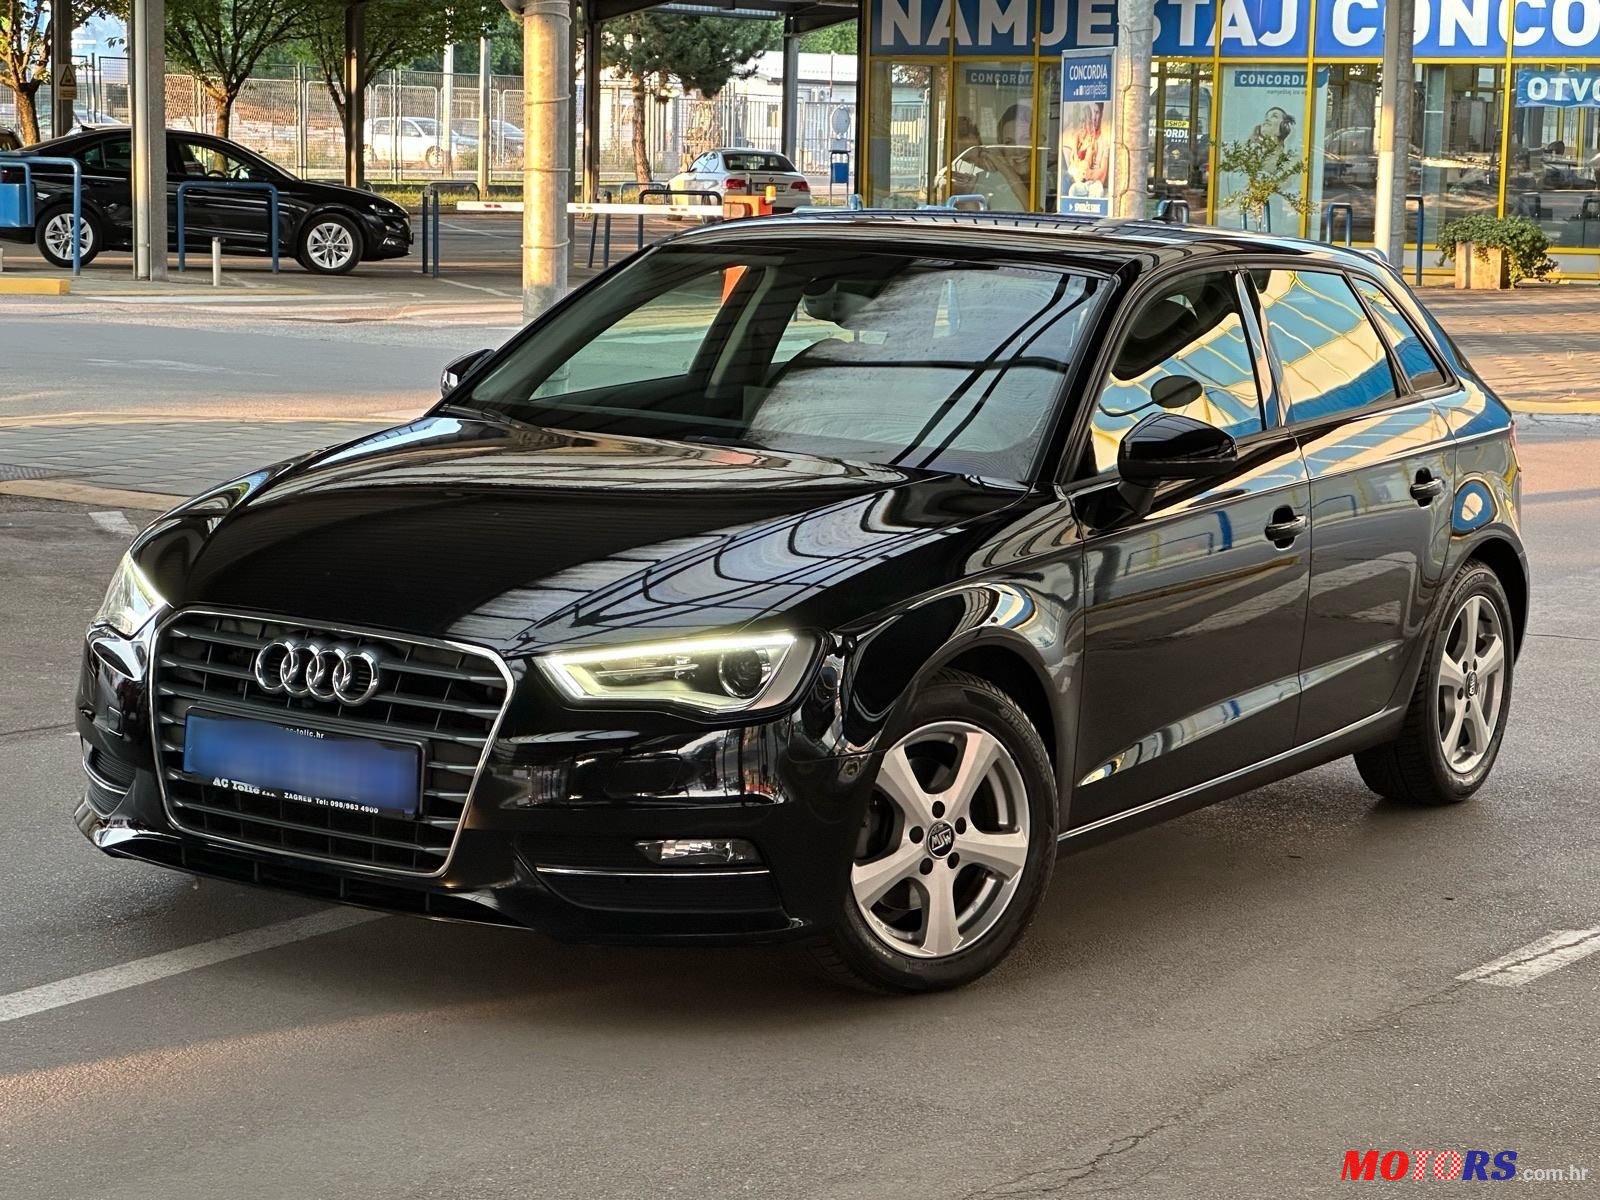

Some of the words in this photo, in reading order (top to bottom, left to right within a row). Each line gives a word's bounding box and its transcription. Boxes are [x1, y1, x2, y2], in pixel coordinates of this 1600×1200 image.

[881, 0, 1298, 47] NAMJETAJ
[1069, 63, 1108, 81] CONCORDIA
[1240, 74, 1308, 86] CONCORDI
[212, 777, 229, 788] AC
